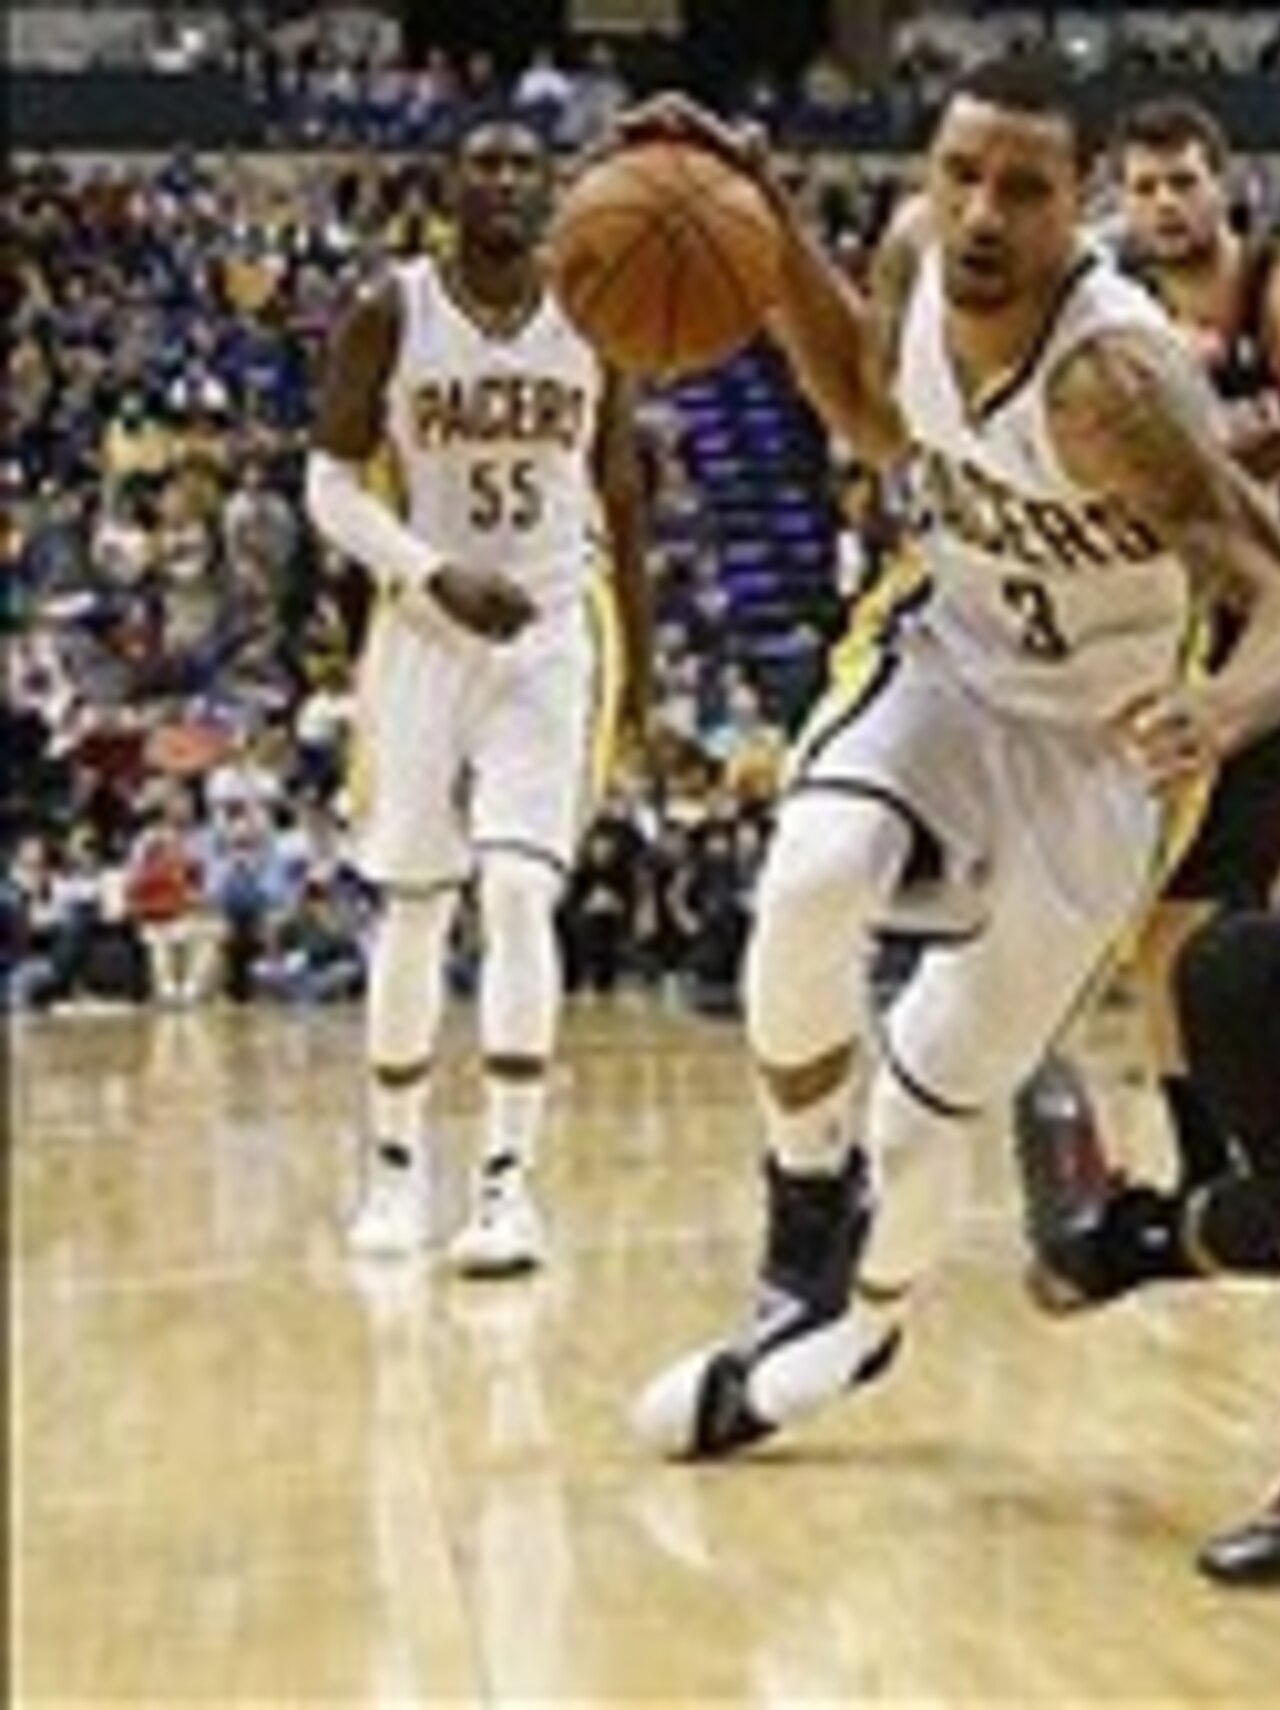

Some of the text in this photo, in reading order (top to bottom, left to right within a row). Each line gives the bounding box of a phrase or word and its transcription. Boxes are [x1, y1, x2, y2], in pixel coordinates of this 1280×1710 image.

[412, 373, 584, 452] PACERS
[467, 459, 545, 534] 55
[1002, 577, 1072, 666] 3
